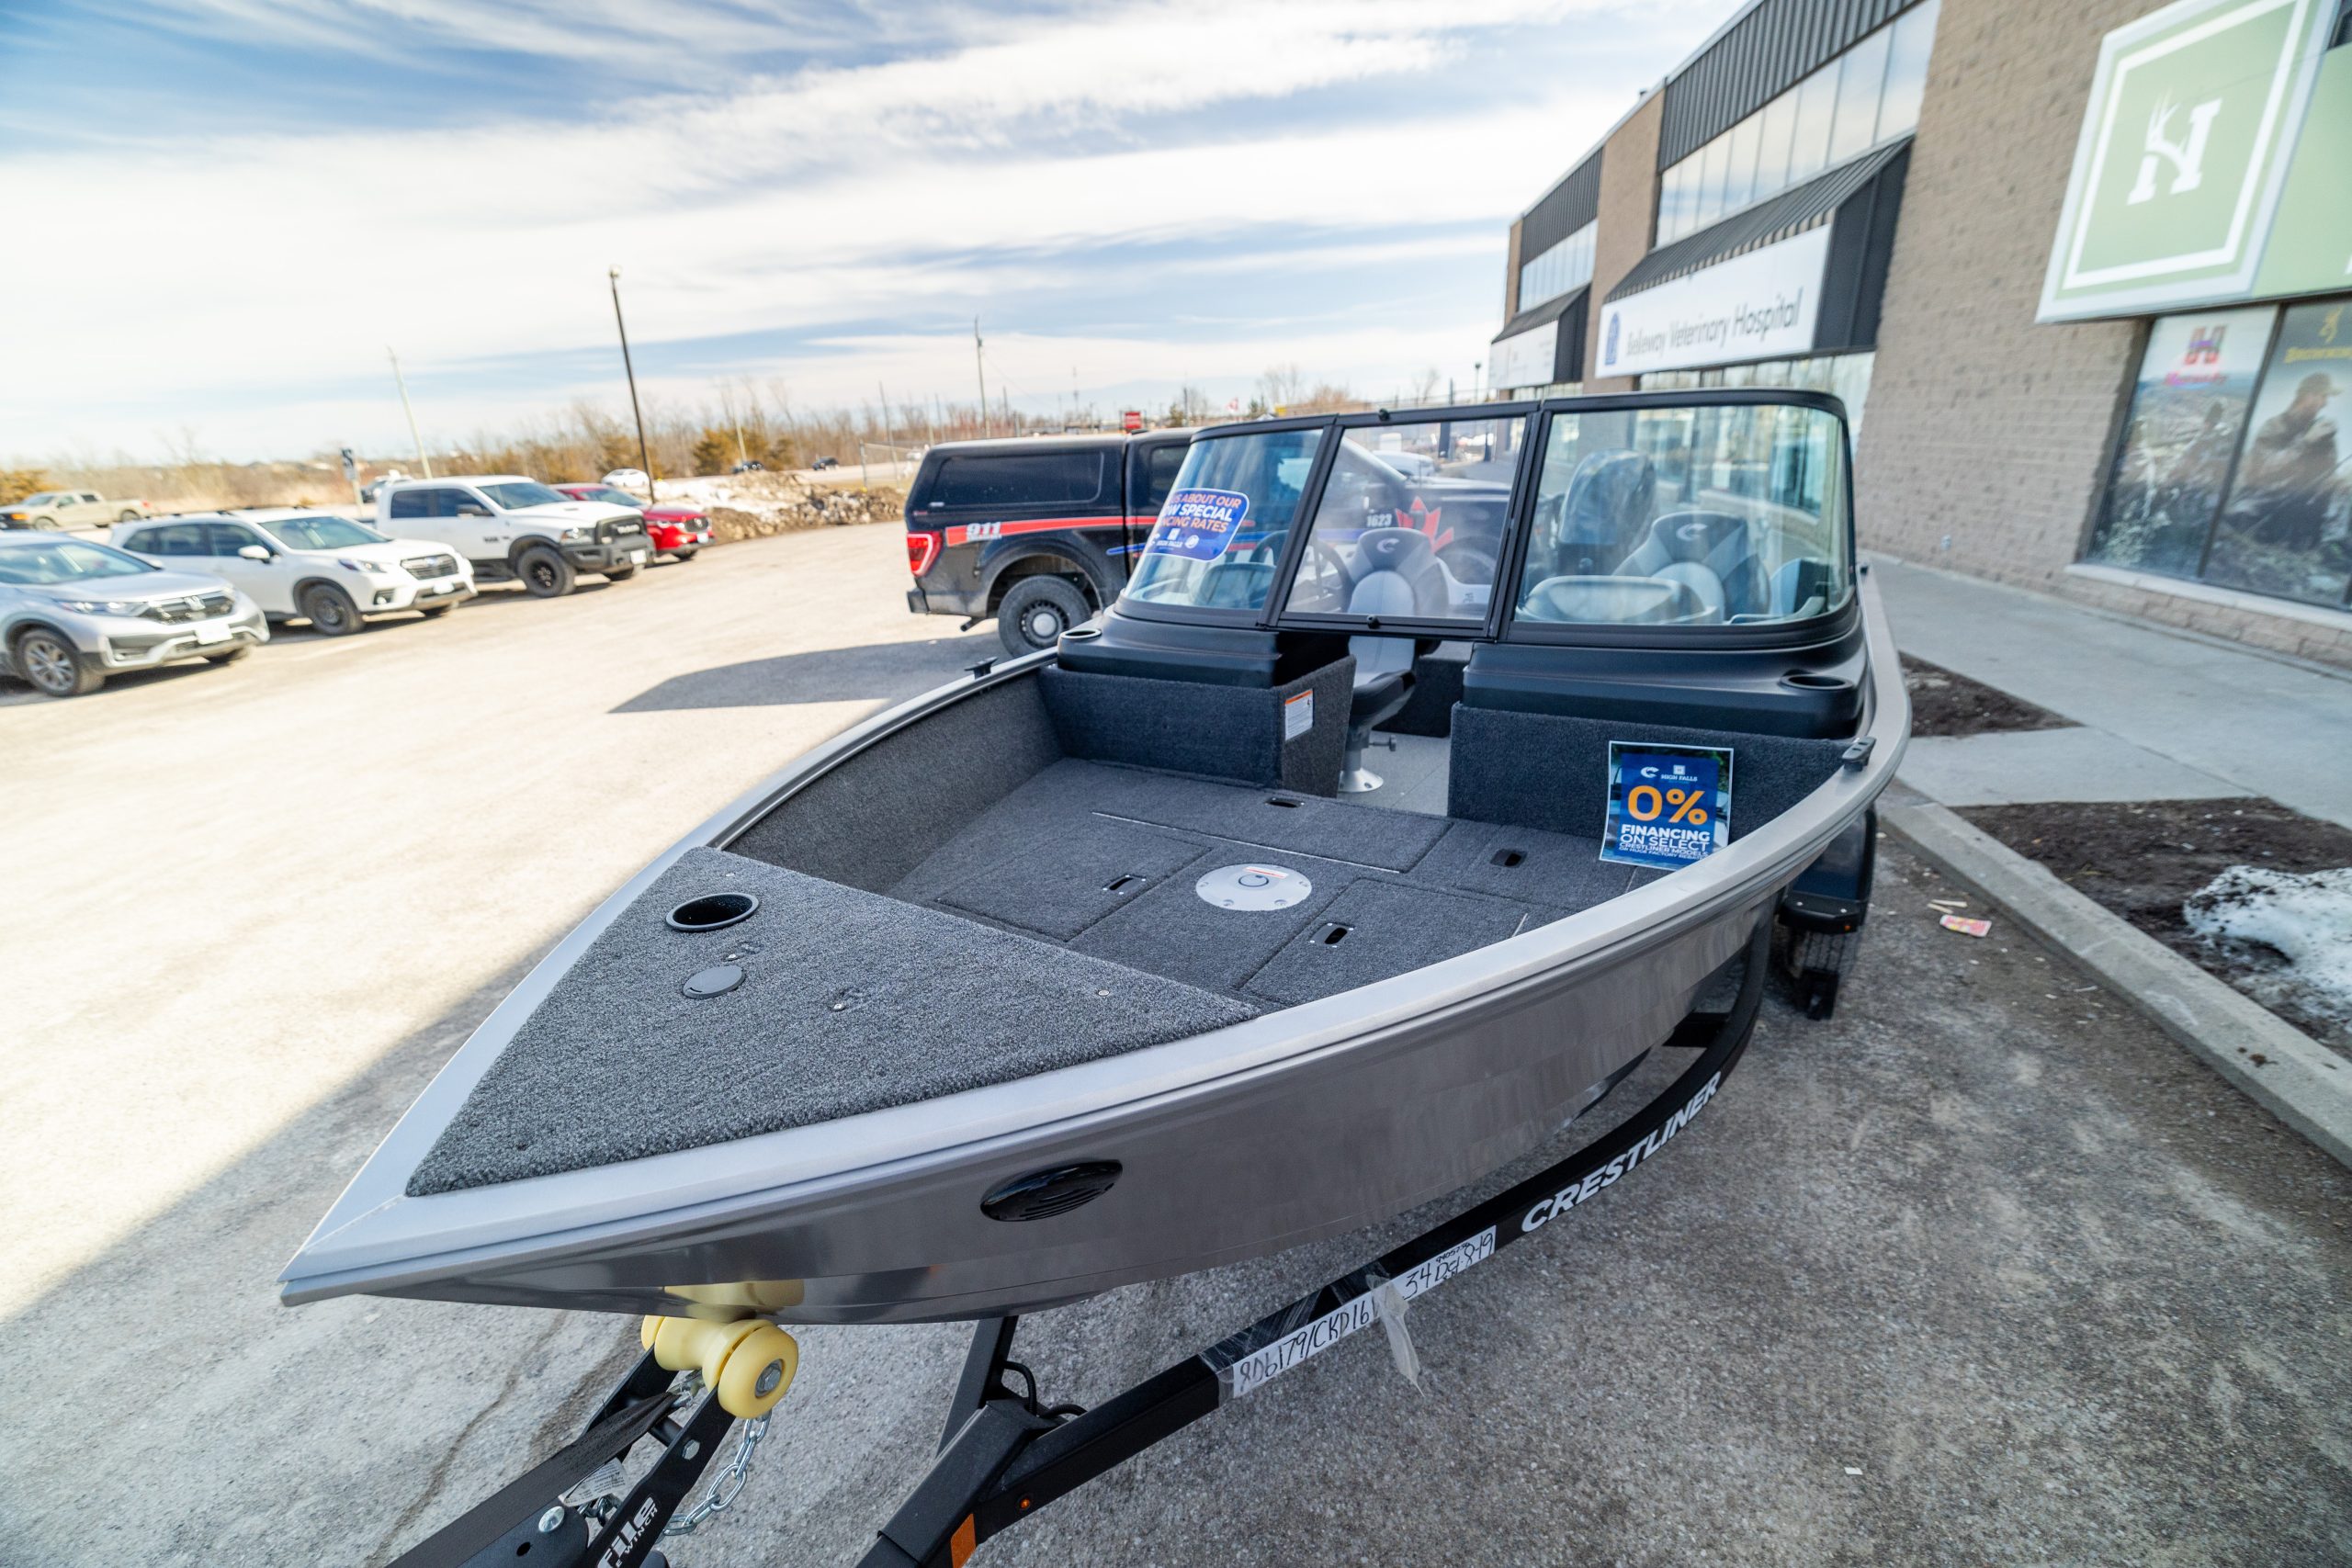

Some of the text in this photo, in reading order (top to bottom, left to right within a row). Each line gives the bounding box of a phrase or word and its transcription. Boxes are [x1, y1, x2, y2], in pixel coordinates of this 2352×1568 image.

[1668, 314, 1731, 348] Veterinary
[1732, 286, 1804, 343] Hospital
[1181, 492, 1216, 506] ABOUT
[1216, 496, 1242, 509] OUR
[1180, 503, 1233, 522] SPECIAL
[967, 522, 1001, 536] 911
[1190, 518, 1228, 533] RATES
[1628, 785, 1708, 825] 0%
[1621, 824, 1710, 841] FINANCING
[1619, 842, 1669, 852] CRESTLINER
[1620, 834, 1710, 852] ON SELECT
[1521, 1071, 1722, 1233] CRESTLINER
[625, 1506, 658, 1554] WINCH
